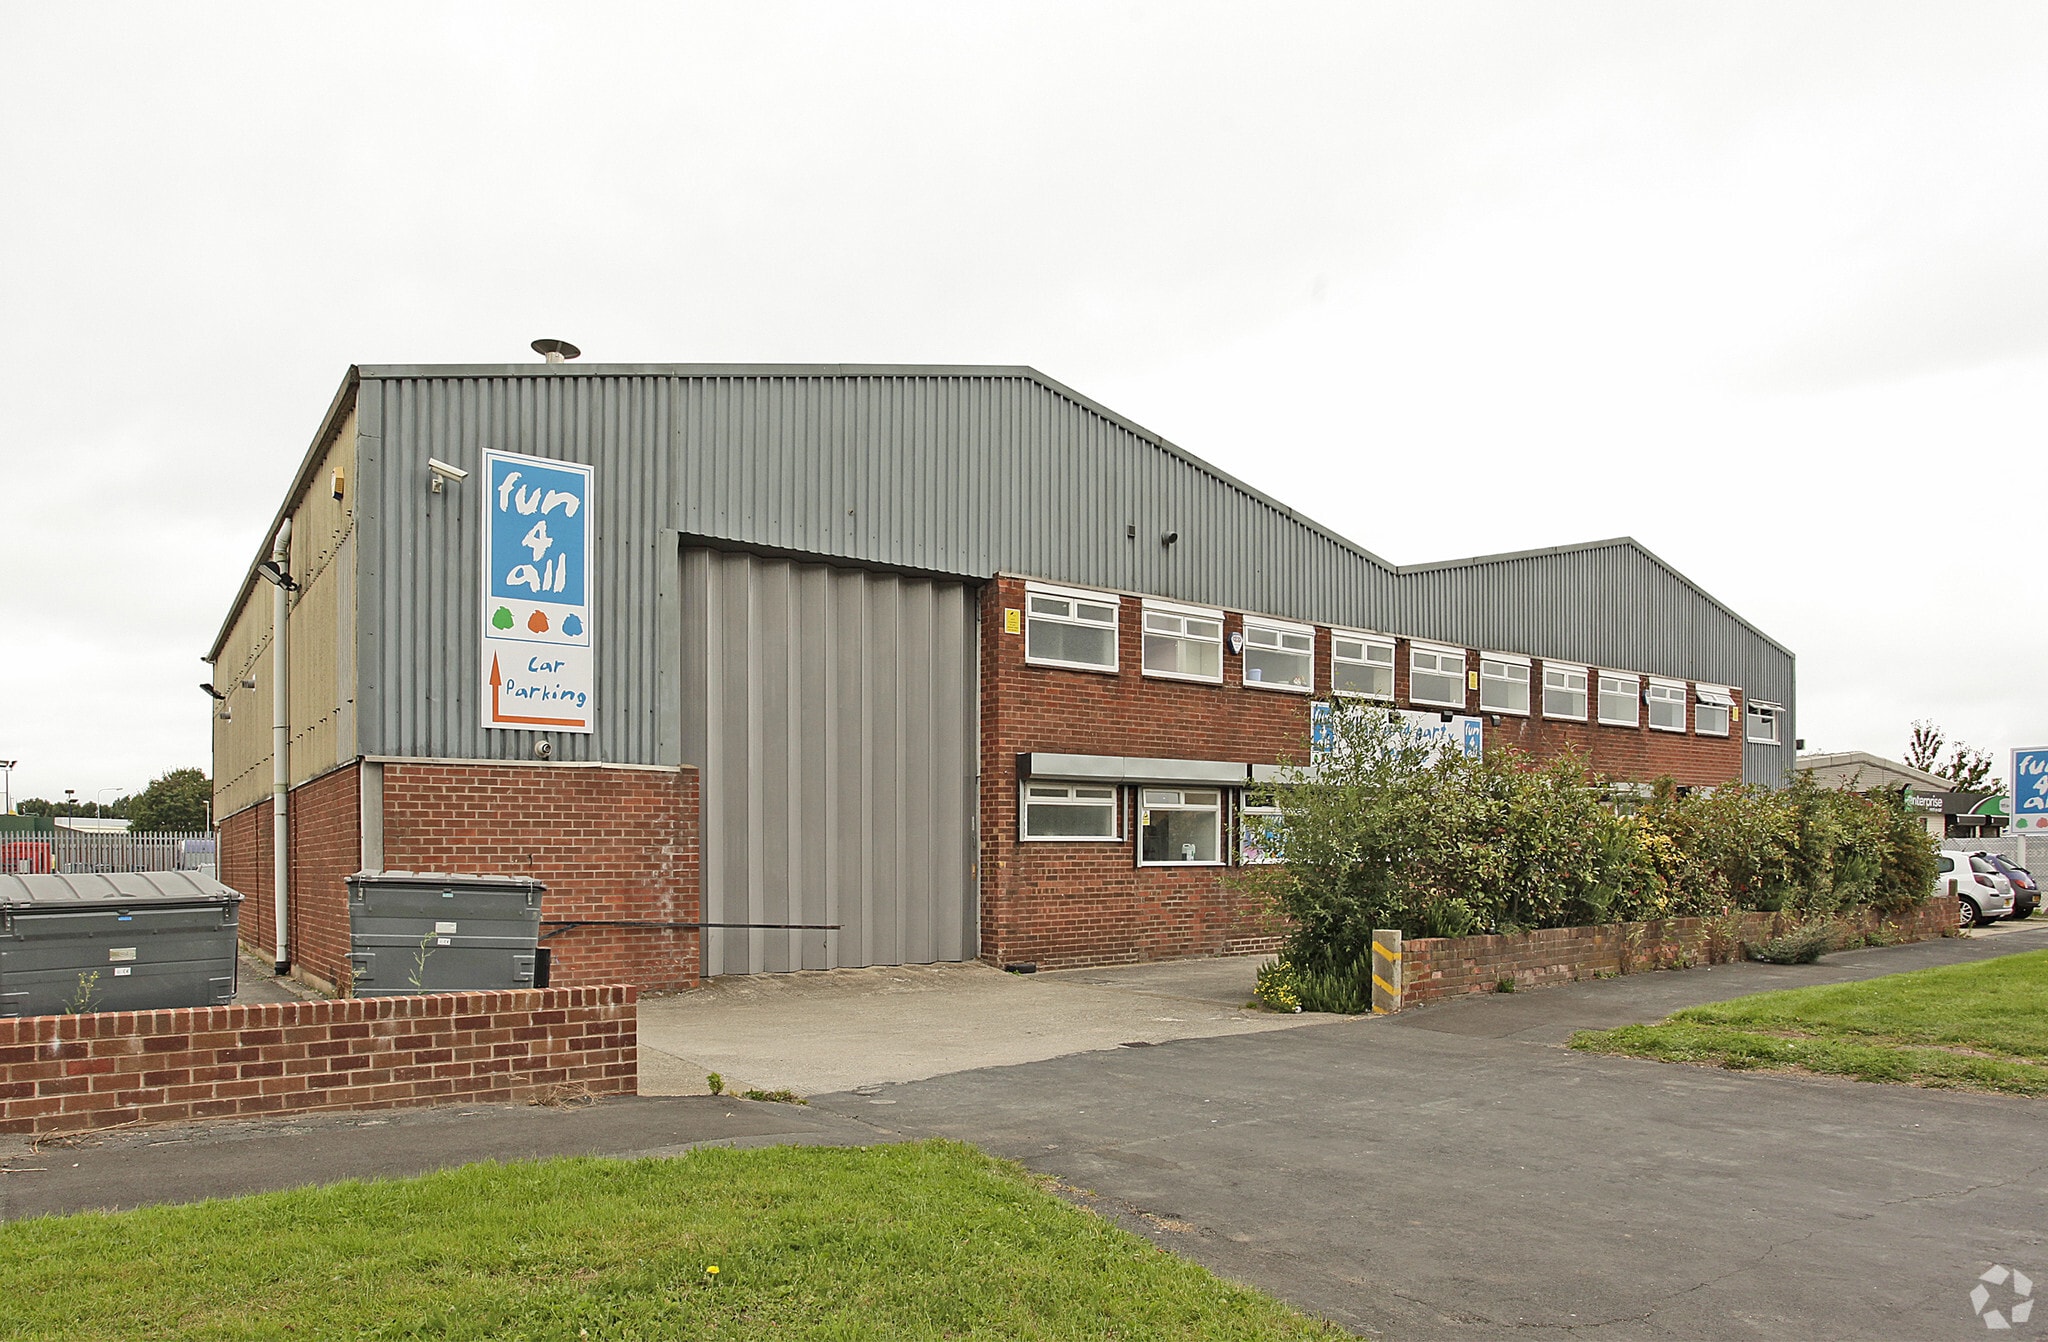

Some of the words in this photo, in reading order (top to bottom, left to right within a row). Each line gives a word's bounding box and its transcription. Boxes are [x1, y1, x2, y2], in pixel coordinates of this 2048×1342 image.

[497, 471, 581, 518] fun
[521, 520, 553, 562] 4
[506, 552, 566, 593] all
[528, 656, 565, 674] Car
[506, 678, 587, 709] Parking
[1465, 722, 1480, 736] fun
[2019, 755, 2048, 775] fu
